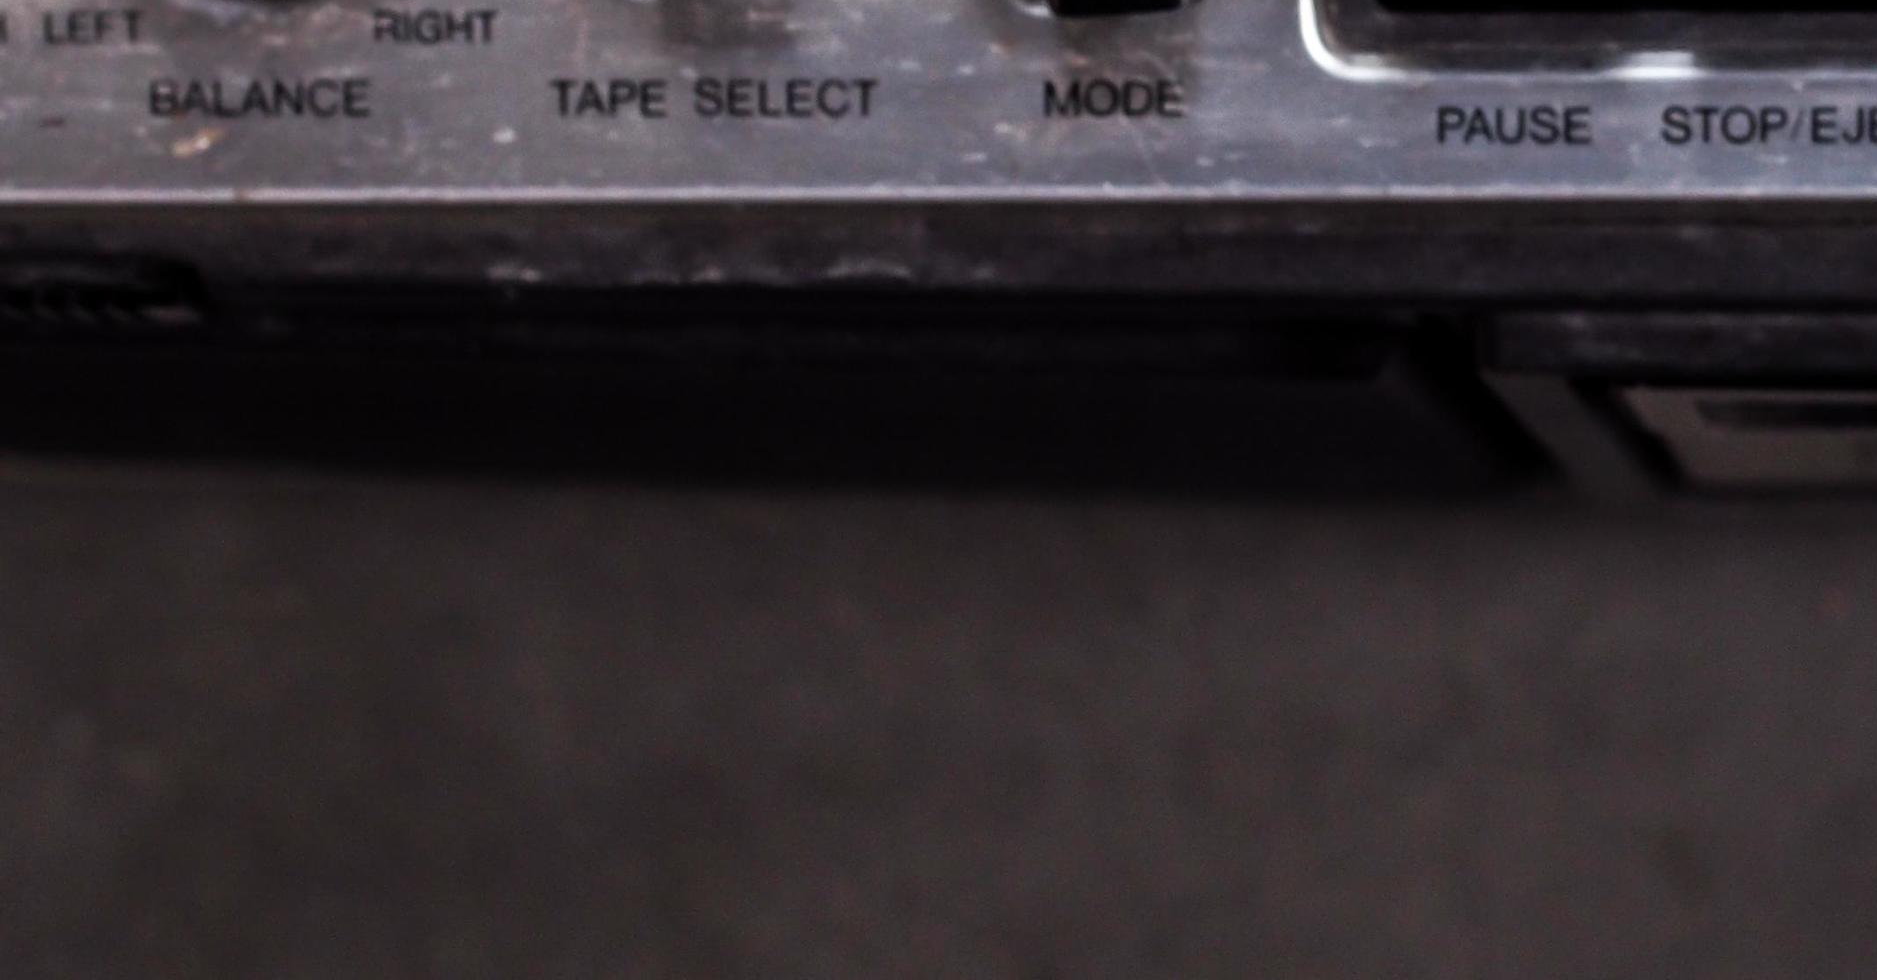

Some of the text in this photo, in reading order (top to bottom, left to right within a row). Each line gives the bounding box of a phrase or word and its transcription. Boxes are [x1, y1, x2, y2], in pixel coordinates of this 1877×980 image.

[43, 8, 144, 45] LEFT
[372, 8, 497, 45] RIGHT
[149, 78, 371, 118] BALANCE
[551, 78, 879, 119] TAPE SELECT
[1043, 79, 1188, 119] MODE
[1436, 106, 1592, 145] PAUSE
